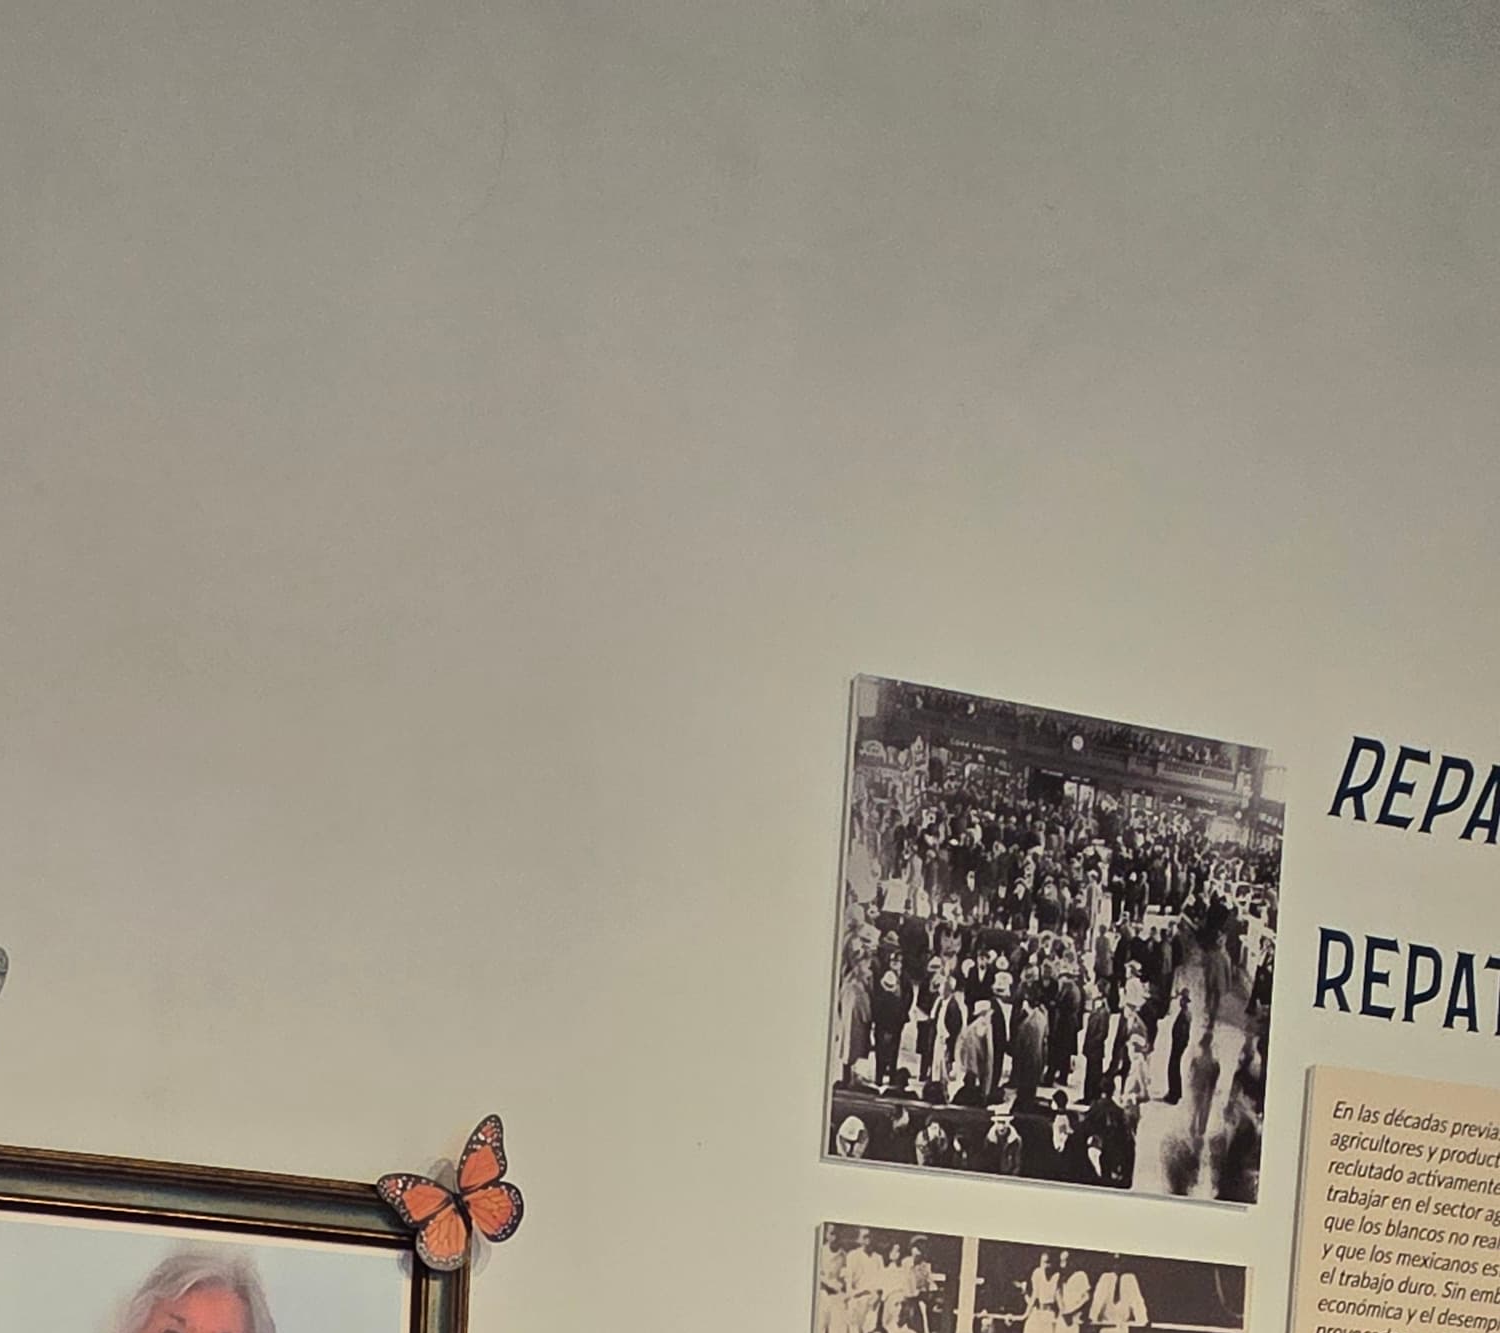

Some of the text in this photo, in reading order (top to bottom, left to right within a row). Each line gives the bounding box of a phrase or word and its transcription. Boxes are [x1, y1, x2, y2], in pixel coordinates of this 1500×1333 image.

[1332, 1100, 1500, 1142] En las décadas previa
[1330, 1131, 1425, 1158] agricultores
[1426, 1146, 1439, 1163] y
[1327, 1159, 1404, 1183] reclutado
